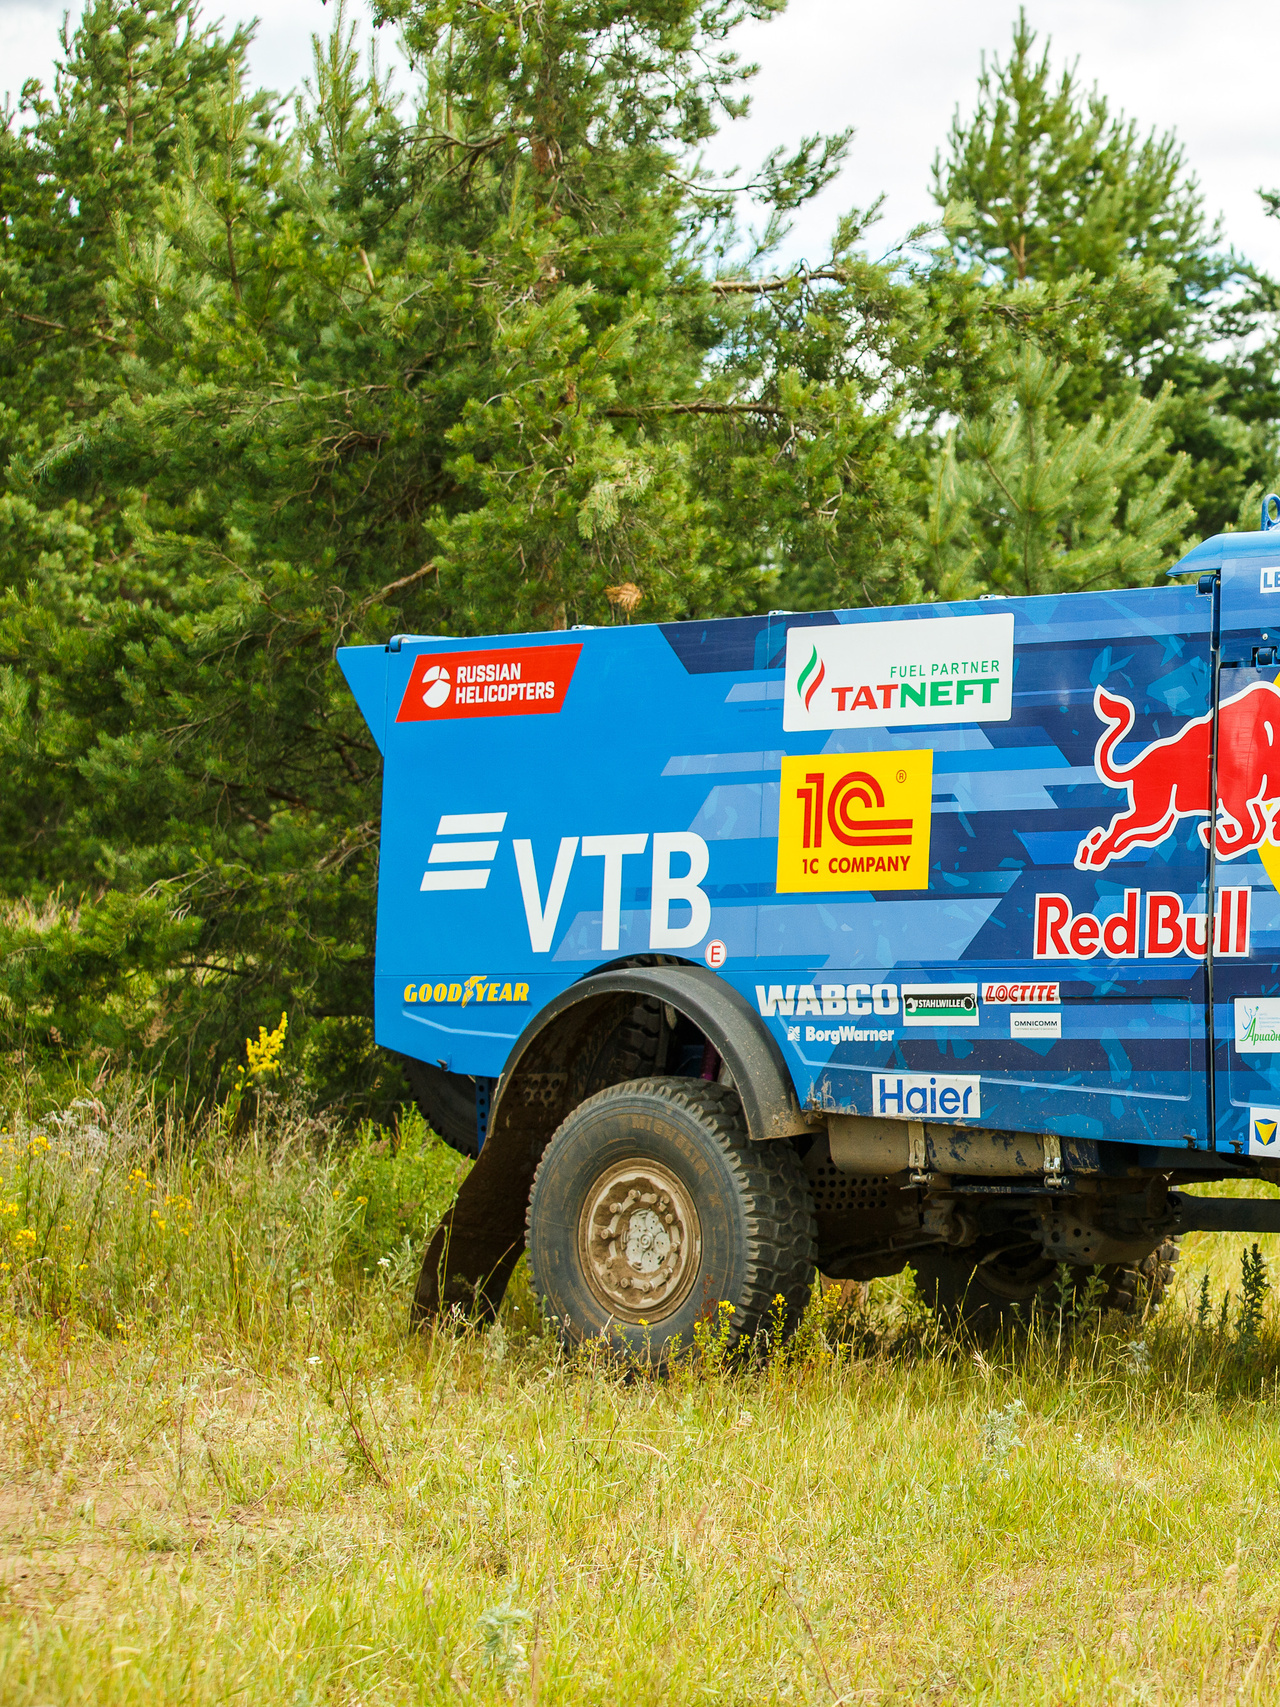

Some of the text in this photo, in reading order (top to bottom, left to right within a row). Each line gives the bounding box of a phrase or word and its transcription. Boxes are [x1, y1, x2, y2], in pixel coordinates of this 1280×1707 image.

[456, 662, 522, 684] RUSSIAN
[890, 660, 1000, 679] FUEL PARTNER
[455, 681, 556, 705] HELICOPTERS
[831, 678, 1000, 712] TATNEFT
[802, 855, 911, 874] 1C COMPANY
[512, 830, 713, 953] VTB
[1035, 886, 1251, 959] Red Bull
[711, 942, 721, 963] E
[755, 983, 899, 1017] WABCO
[918, 999, 960, 1008] STAHLWILLE
[985, 984, 1058, 1003] LOCTITE
[805, 1026, 895, 1045] BorgWarner
[879, 1078, 973, 1115] Haier
[631, 1114, 711, 1176] MICHELIN
